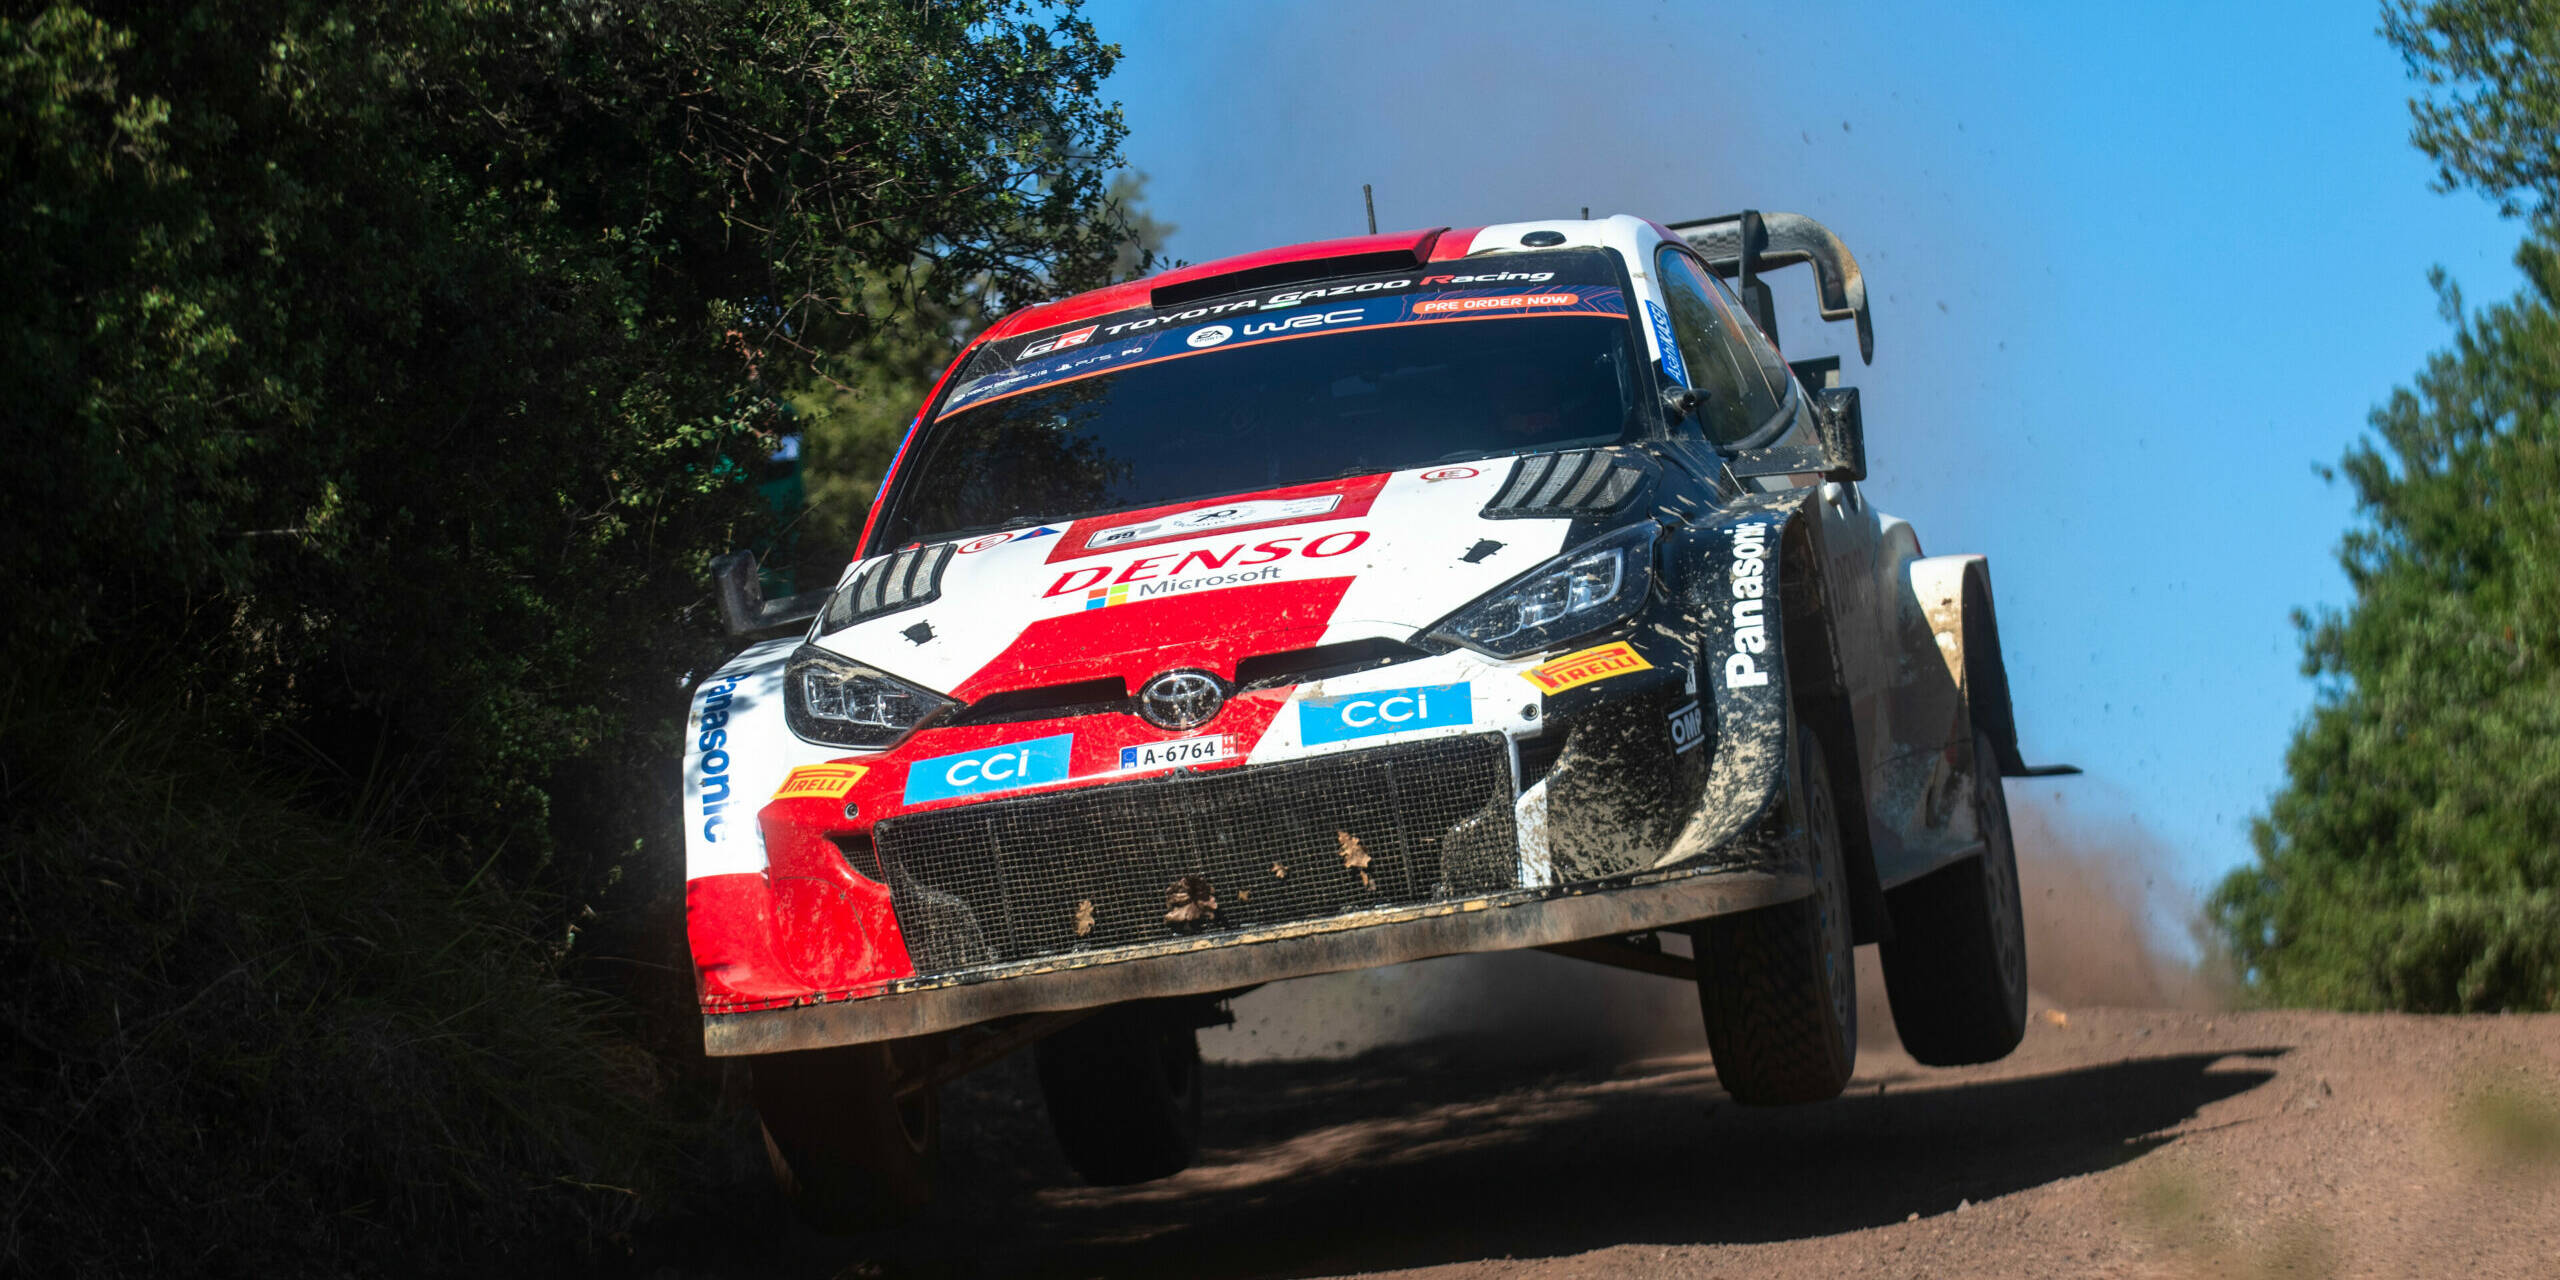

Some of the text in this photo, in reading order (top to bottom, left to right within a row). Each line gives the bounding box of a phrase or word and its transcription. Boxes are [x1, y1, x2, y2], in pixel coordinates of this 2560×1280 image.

[1018, 271, 1555, 360] GR TOYOTA GAZOO Racing
[1423, 295, 1568, 312] PRE ORDER NOW
[1243, 308, 1365, 336] WRC
[1107, 531, 1136, 541] 69
[1042, 530, 1371, 598] DENSO
[1138, 565, 1282, 597] Microsoft
[1724, 522, 1769, 689] Panasonic
[1533, 647, 1639, 689] PIRELLI
[1671, 707, 1702, 745] OMP
[698, 672, 754, 843] Panasonic
[1143, 741, 1216, 765] A-6764
[779, 768, 857, 794] PIRELLI
